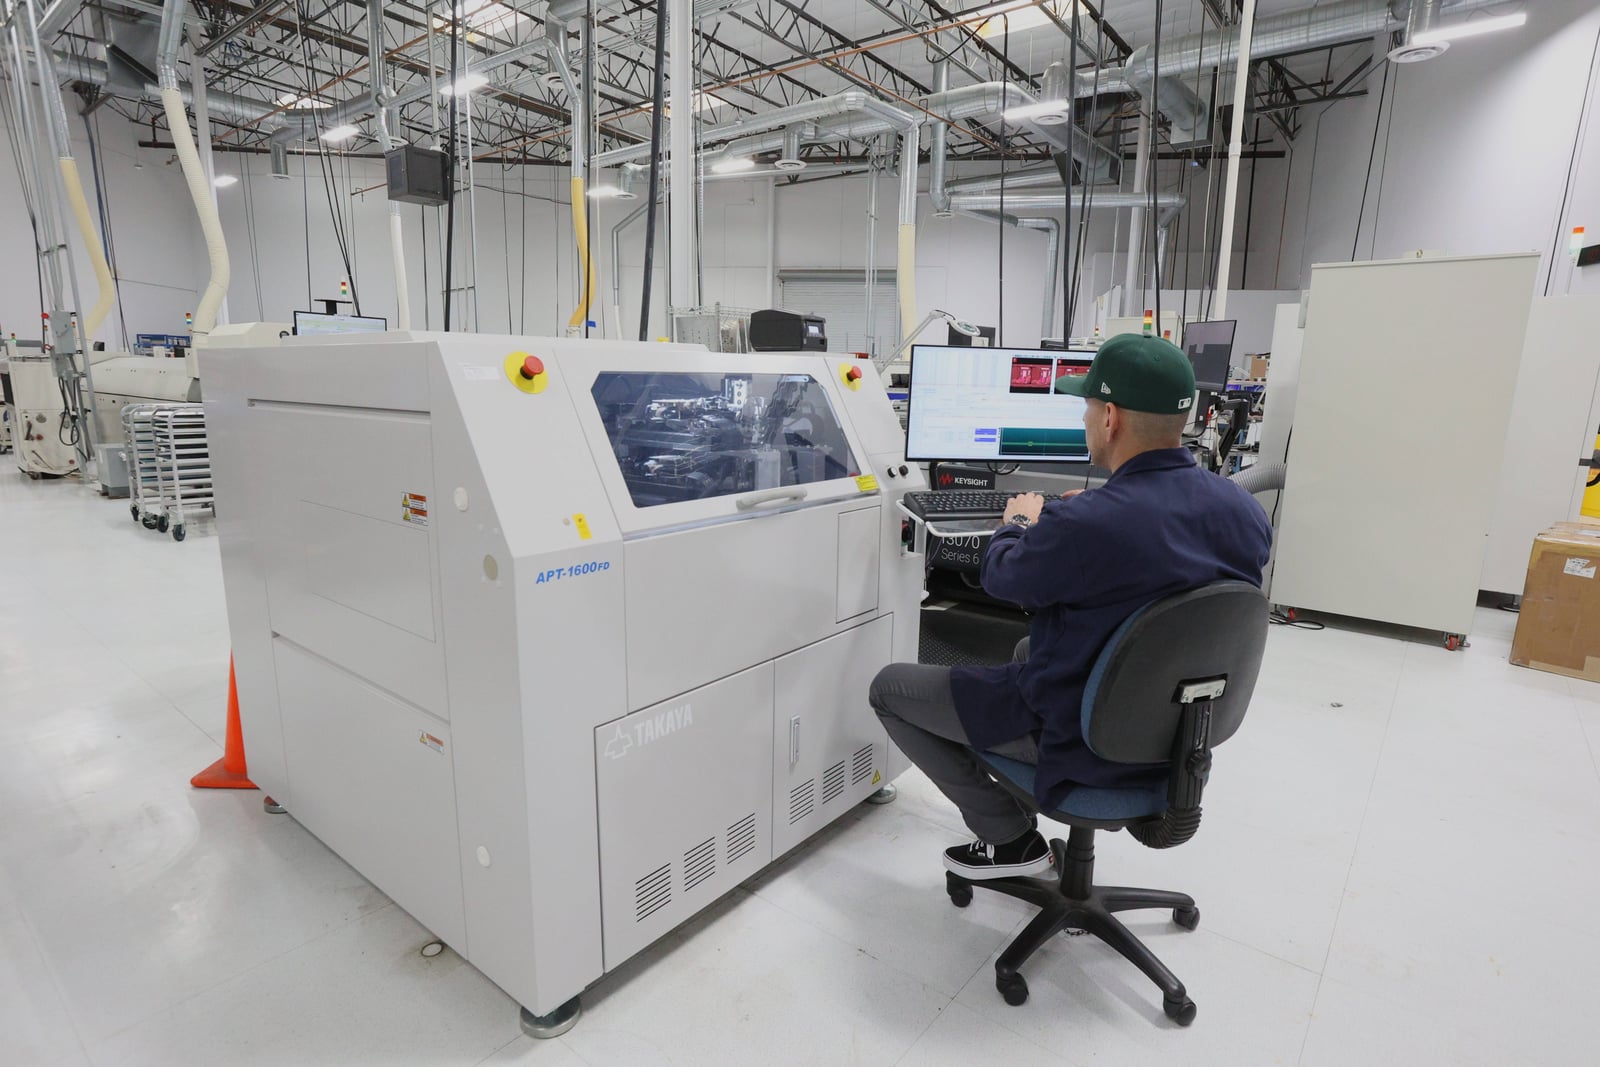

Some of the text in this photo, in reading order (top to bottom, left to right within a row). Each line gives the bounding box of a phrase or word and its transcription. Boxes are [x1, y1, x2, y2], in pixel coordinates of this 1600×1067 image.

[954, 476, 988, 487] KEYSIGHT
[941, 547, 980, 565] Series 6
[535, 561, 610, 584] APT-1600FD
[634, 704, 693, 746] TAKAYA
